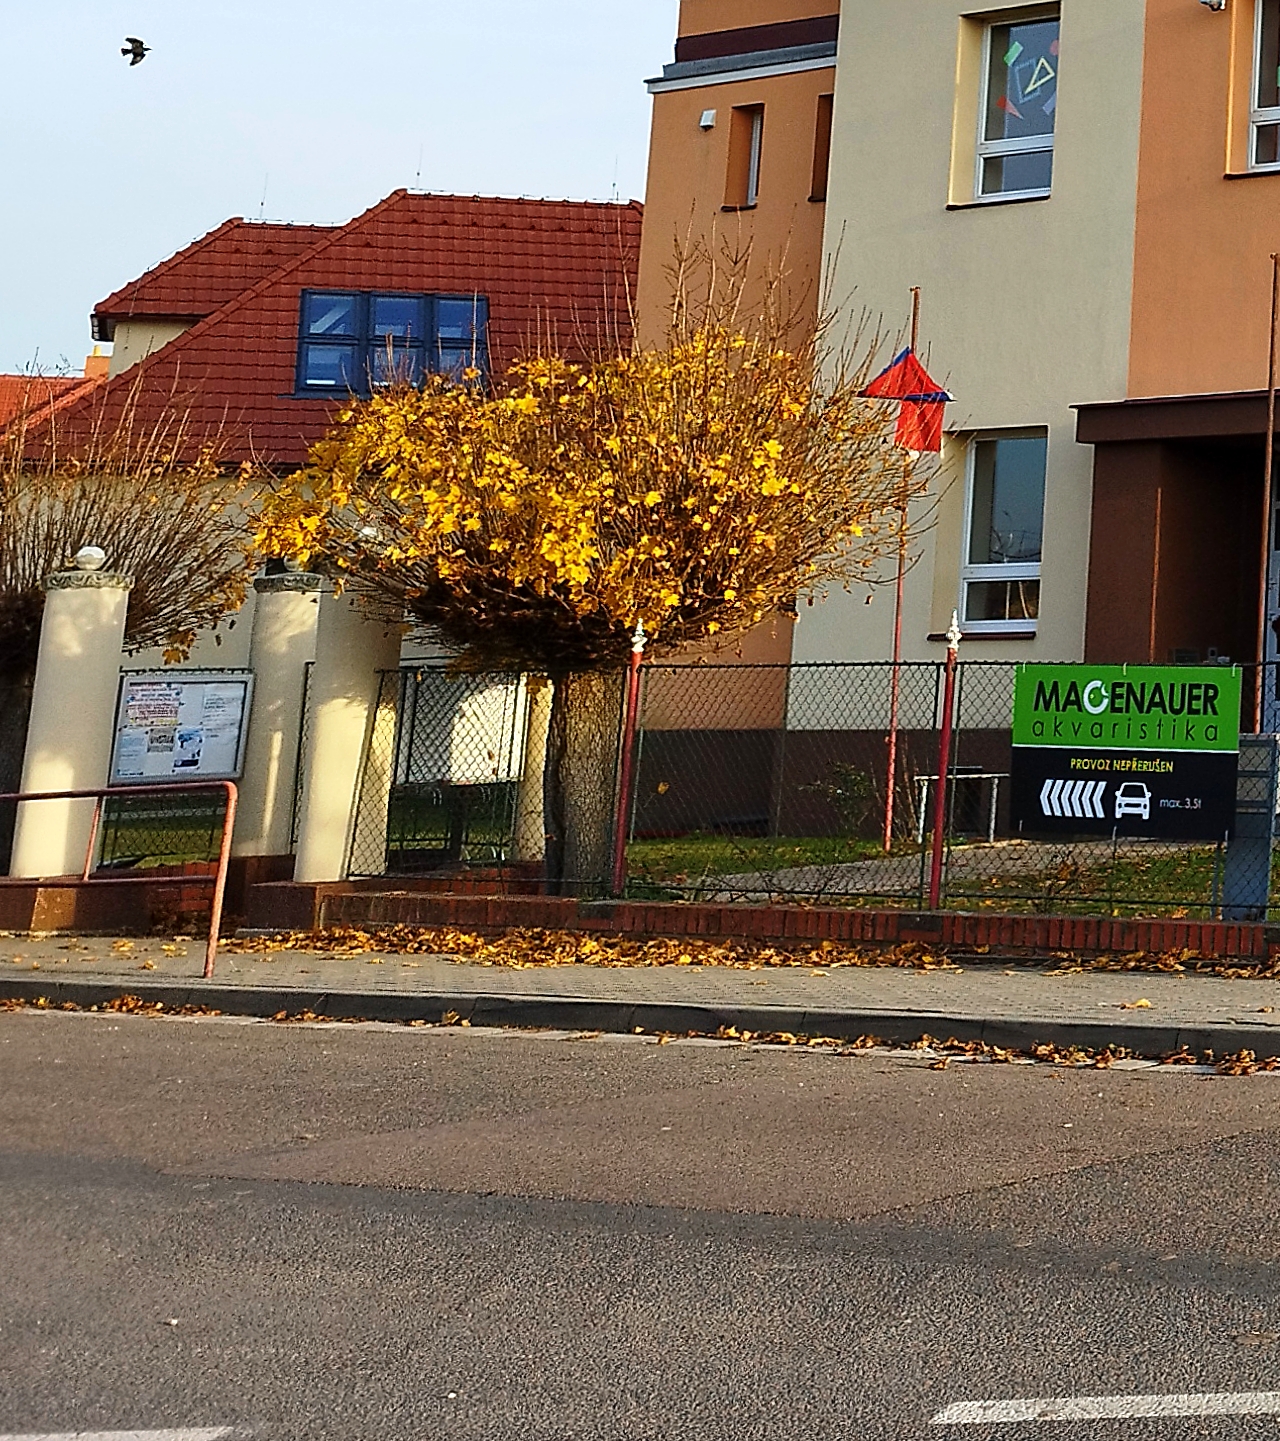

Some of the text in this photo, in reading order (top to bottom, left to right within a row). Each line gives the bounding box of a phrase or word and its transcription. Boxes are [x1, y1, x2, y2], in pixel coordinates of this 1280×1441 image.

[1032, 716, 1218, 741] akvaristika
[1070, 757, 1174, 773] PROVOZ NEPŘERUŠEN
